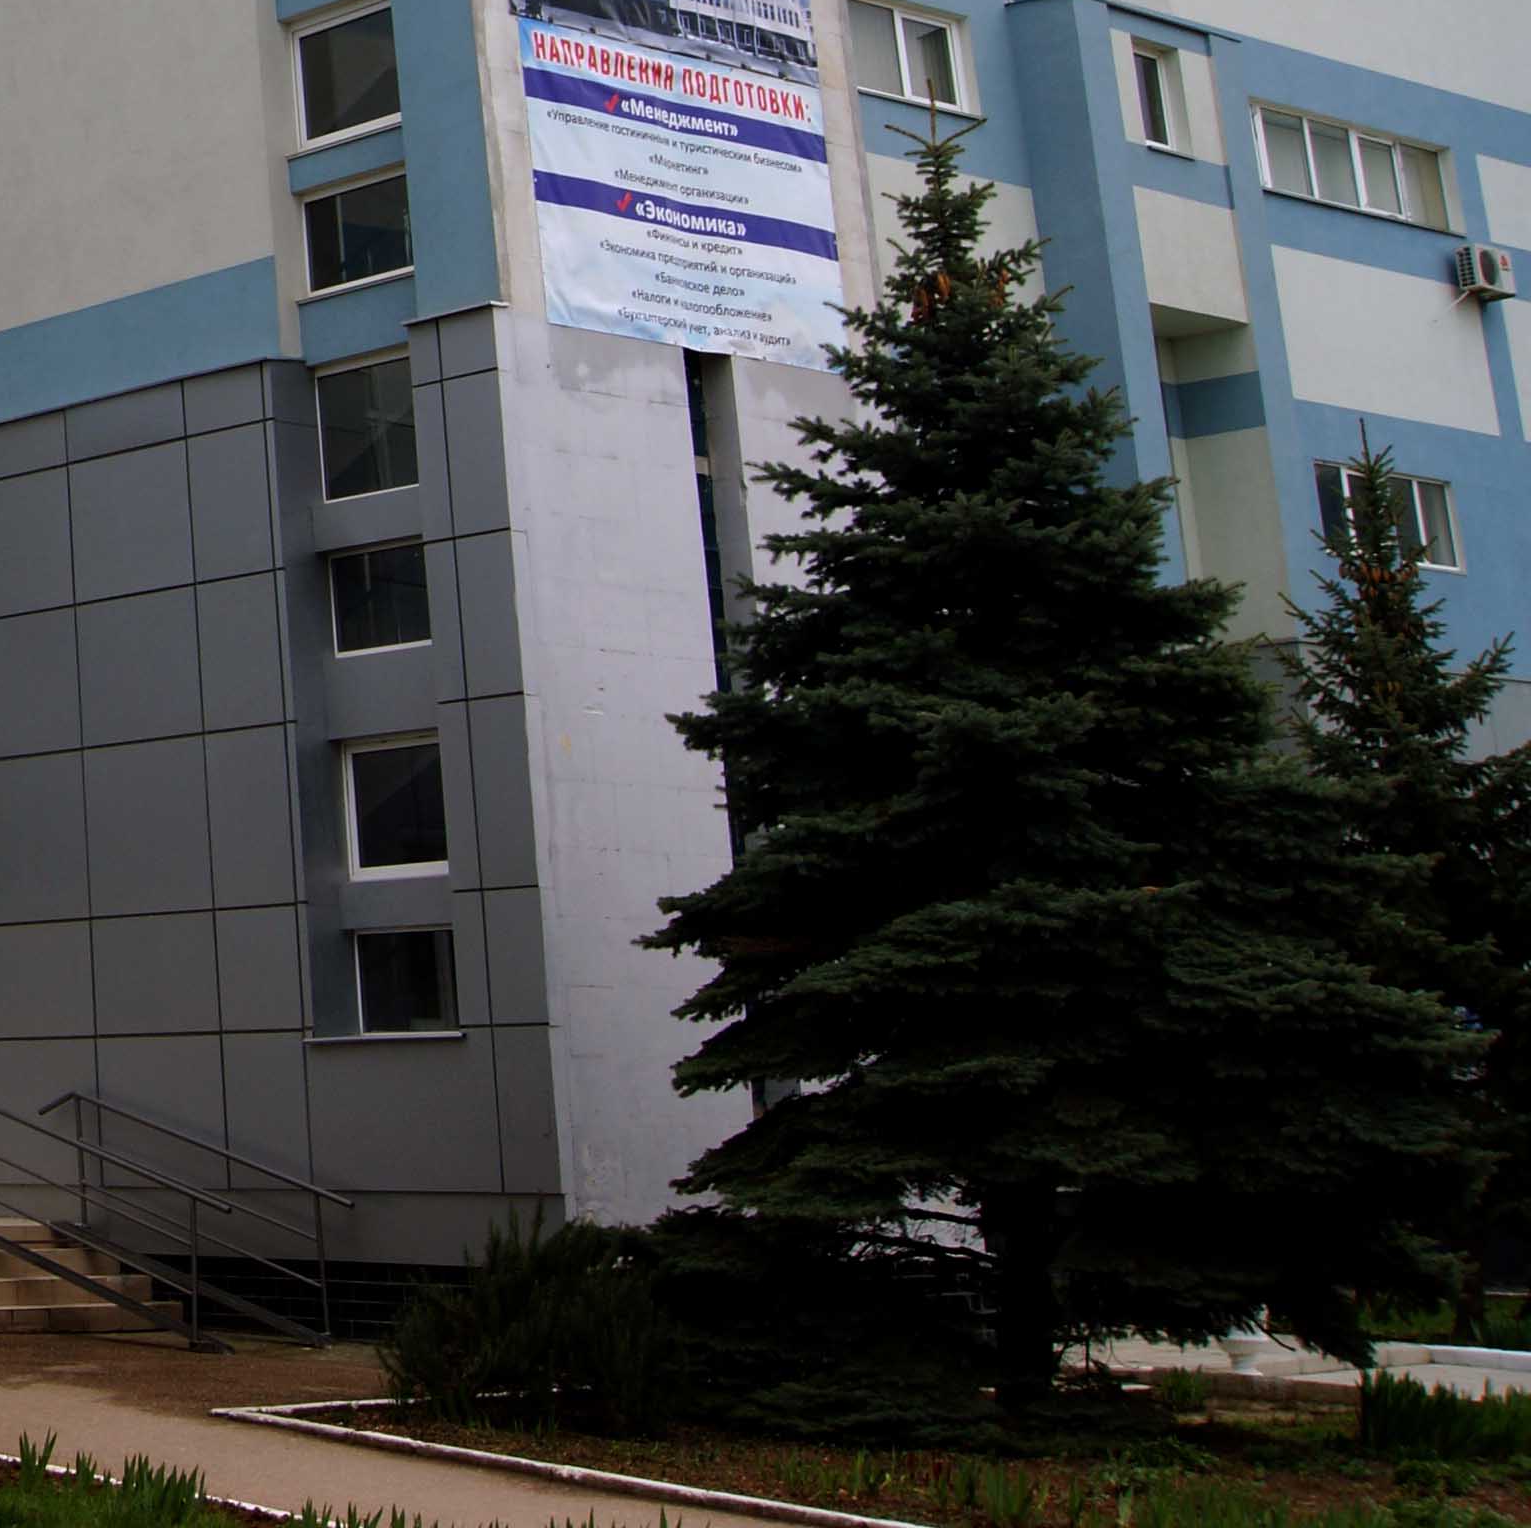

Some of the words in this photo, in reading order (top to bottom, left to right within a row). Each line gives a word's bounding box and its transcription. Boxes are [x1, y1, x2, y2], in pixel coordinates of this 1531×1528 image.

[533, 31, 674, 91] НАПРАВЛЕНИЯ
[682, 68, 812, 123] ПОДГОТОВКИ:
[621, 97, 739, 137] «Менеджмент»
[635, 199, 747, 237] «Экономика»
